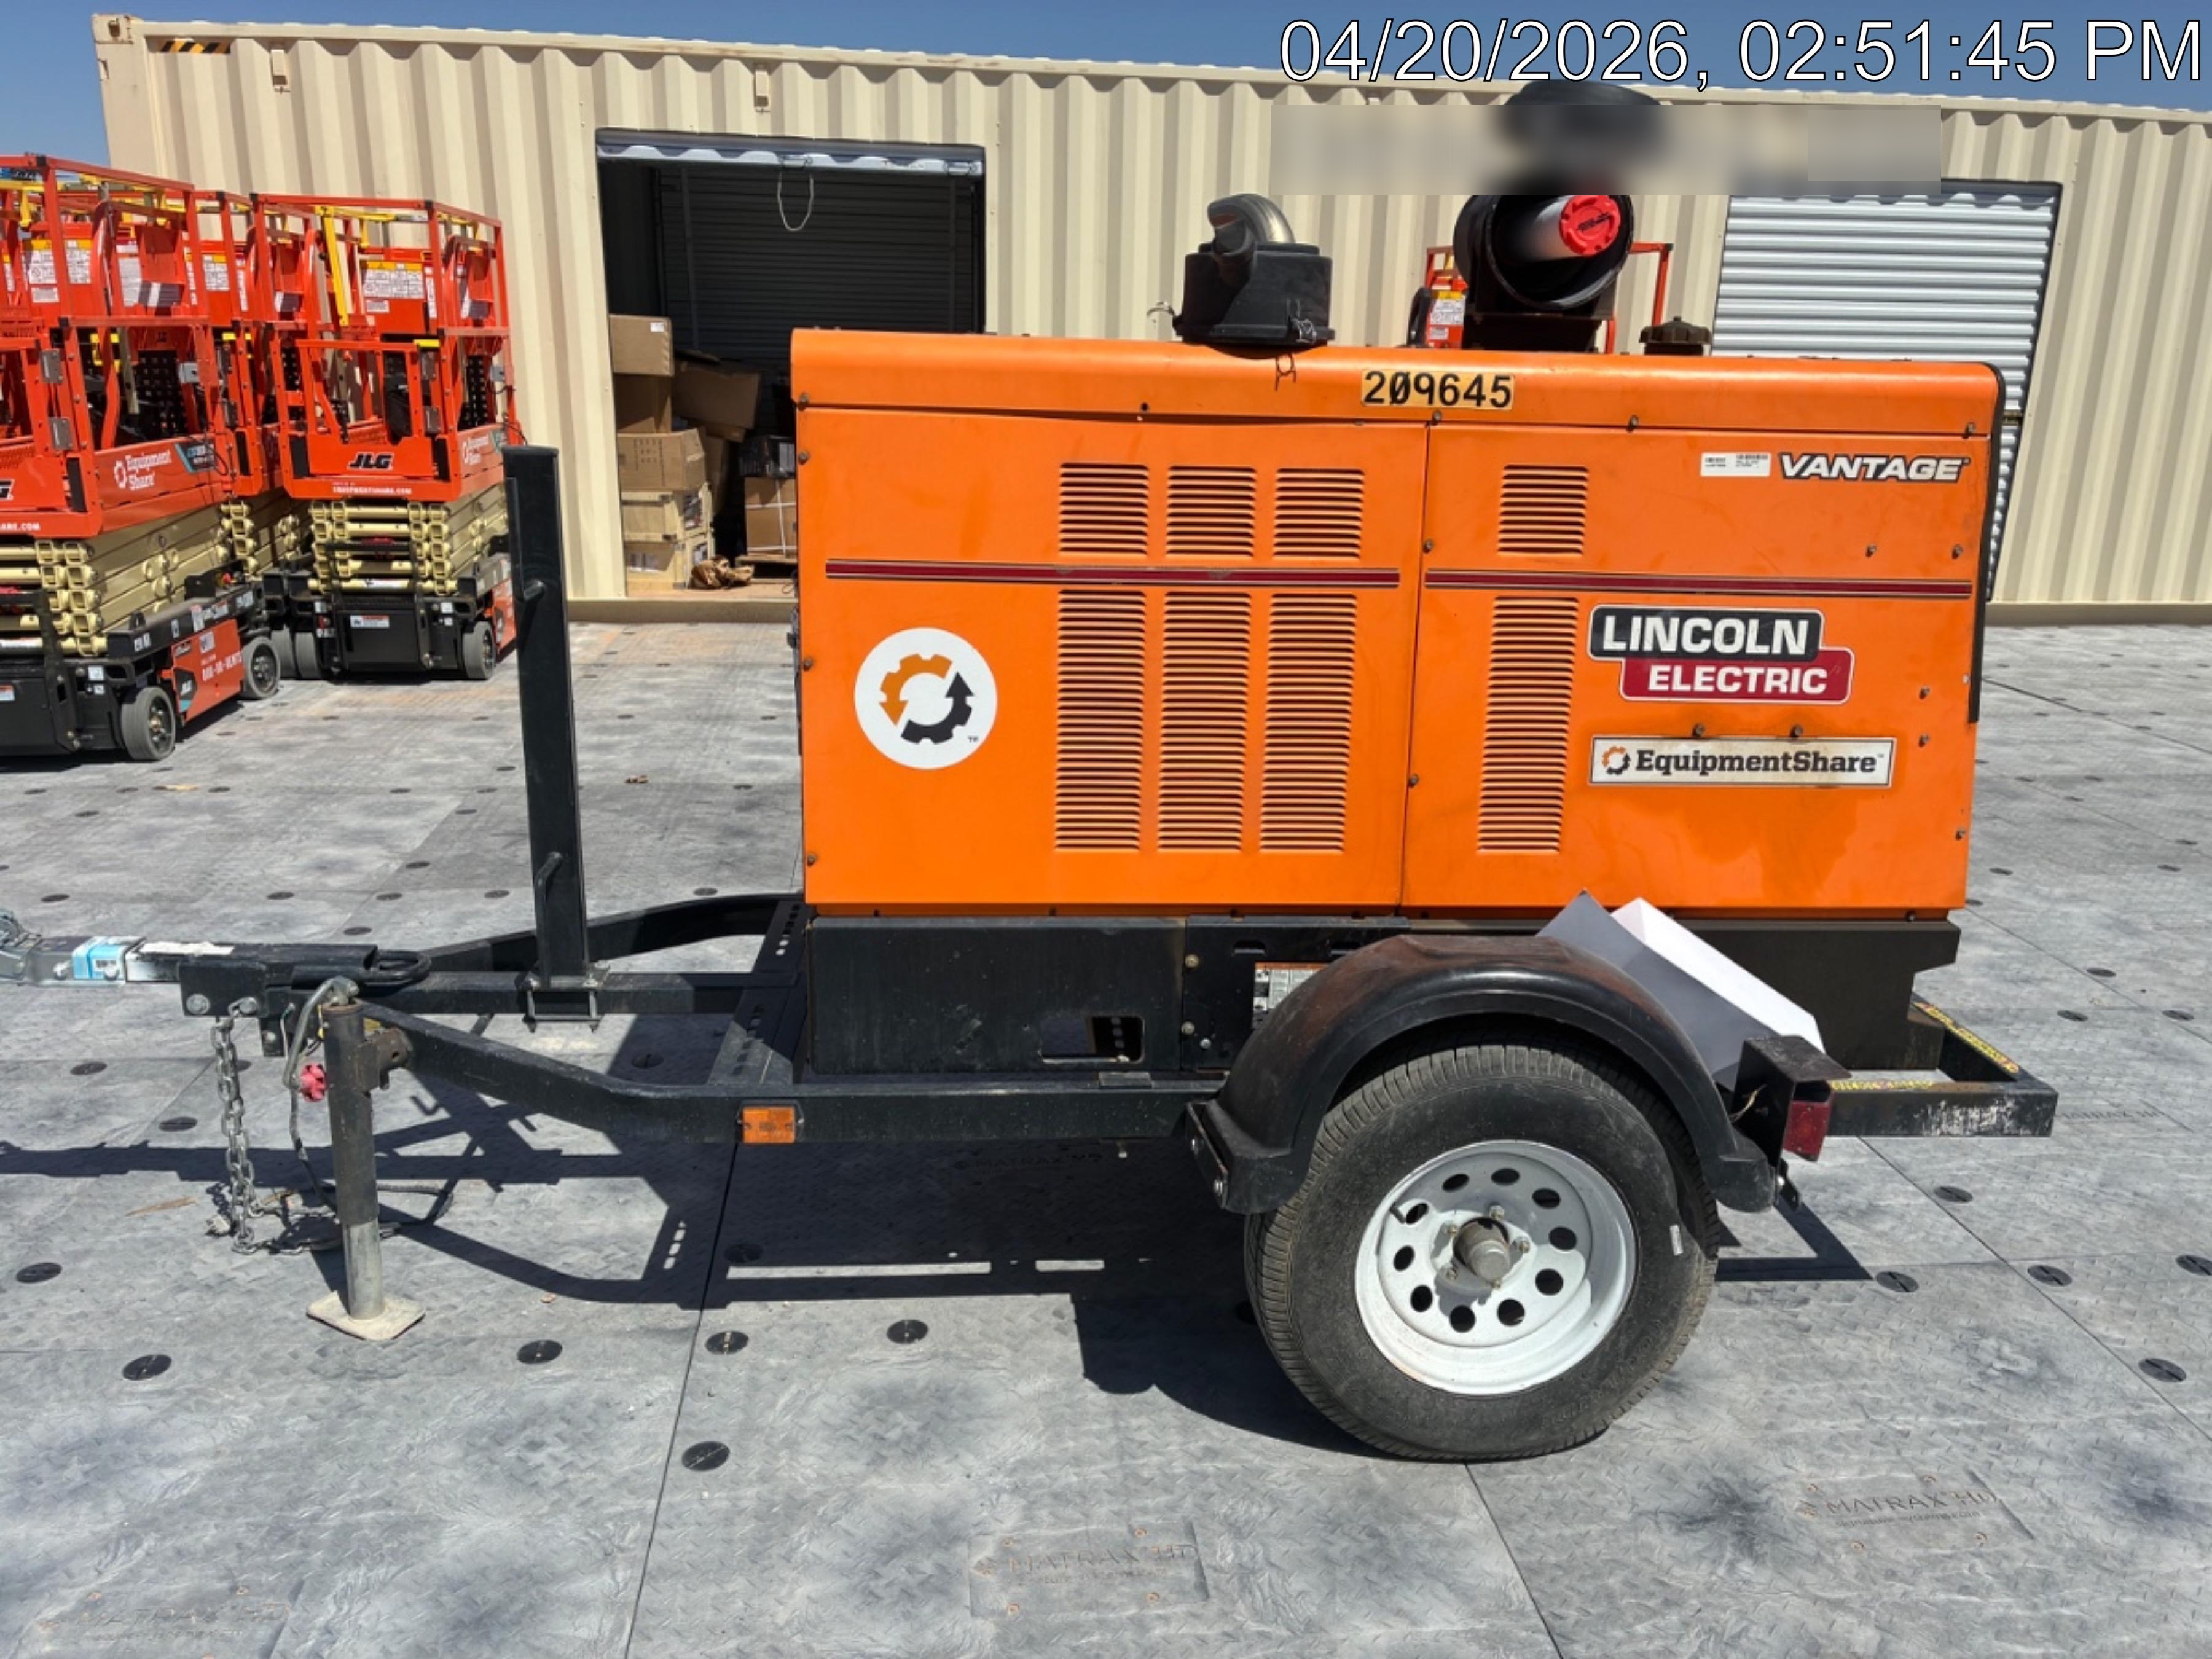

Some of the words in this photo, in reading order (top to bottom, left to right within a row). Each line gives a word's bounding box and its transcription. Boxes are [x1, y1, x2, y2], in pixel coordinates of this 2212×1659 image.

[1363, 370, 1511, 409] 209645
[348, 453, 393, 469] JLG
[1780, 453, 1966, 482] VANTAGE
[1602, 615, 1808, 655] LINCOLN
[1648, 665, 1827, 694] ELECTRIC
[1636, 749, 1877, 777] EquipmentShare
